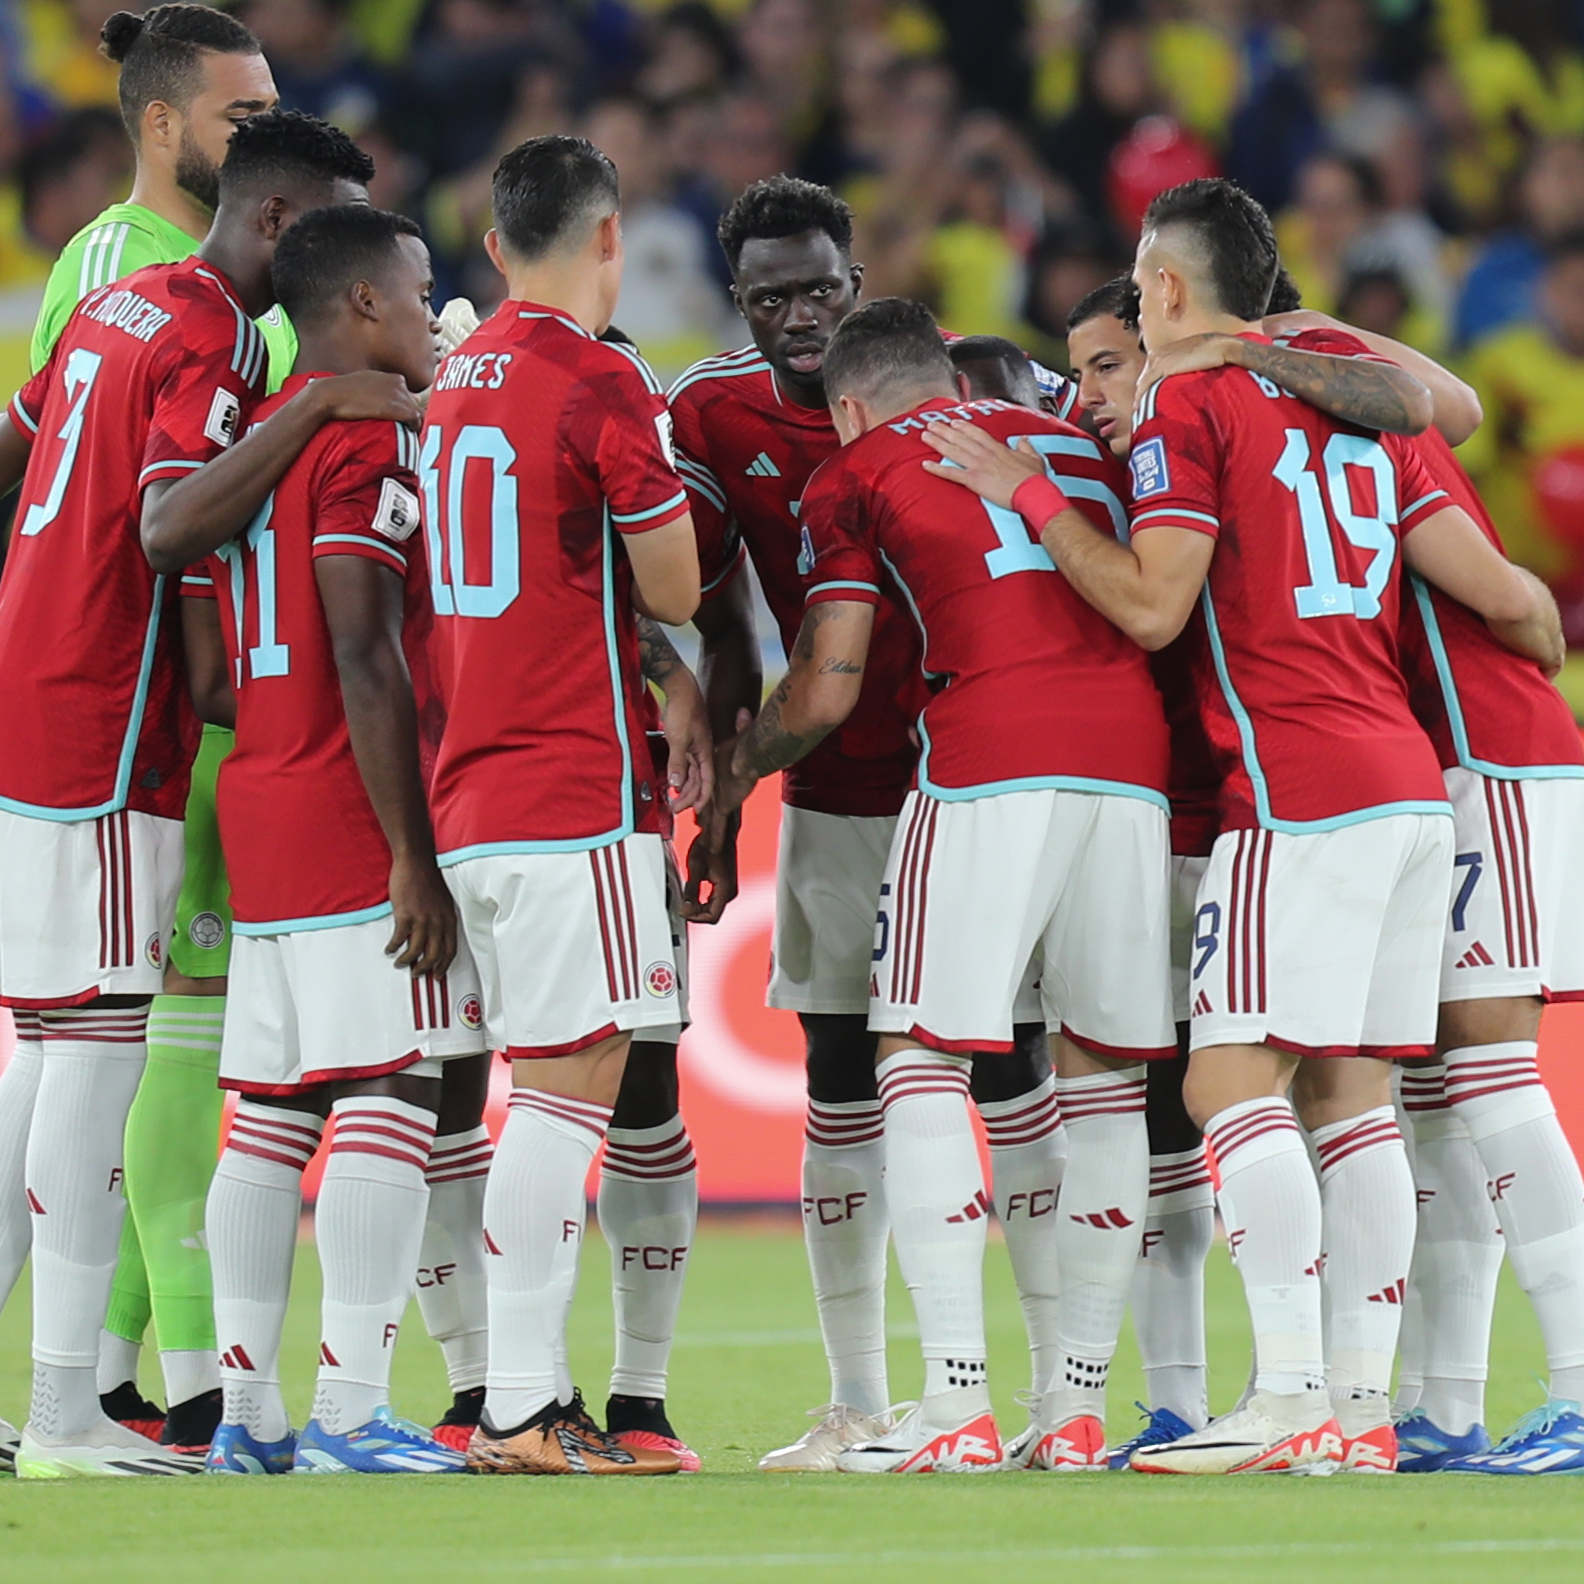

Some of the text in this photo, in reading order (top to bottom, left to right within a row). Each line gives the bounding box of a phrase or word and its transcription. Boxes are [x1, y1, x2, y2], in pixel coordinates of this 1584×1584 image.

[436, 352, 513, 392] JAMES
[887, 398, 1049, 435] MATH
[419, 424, 521, 619] 10
[939, 433, 1129, 580] 15
[1271, 428, 1399, 620] 19
[1451, 850, 1483, 932] 7
[1193, 900, 1221, 980] 9
[803, 1191, 868, 1226] FCF
[1007, 1182, 1061, 1222] FC
[415, 1262, 458, 1288] CF
[622, 1246, 688, 1271] FCF
